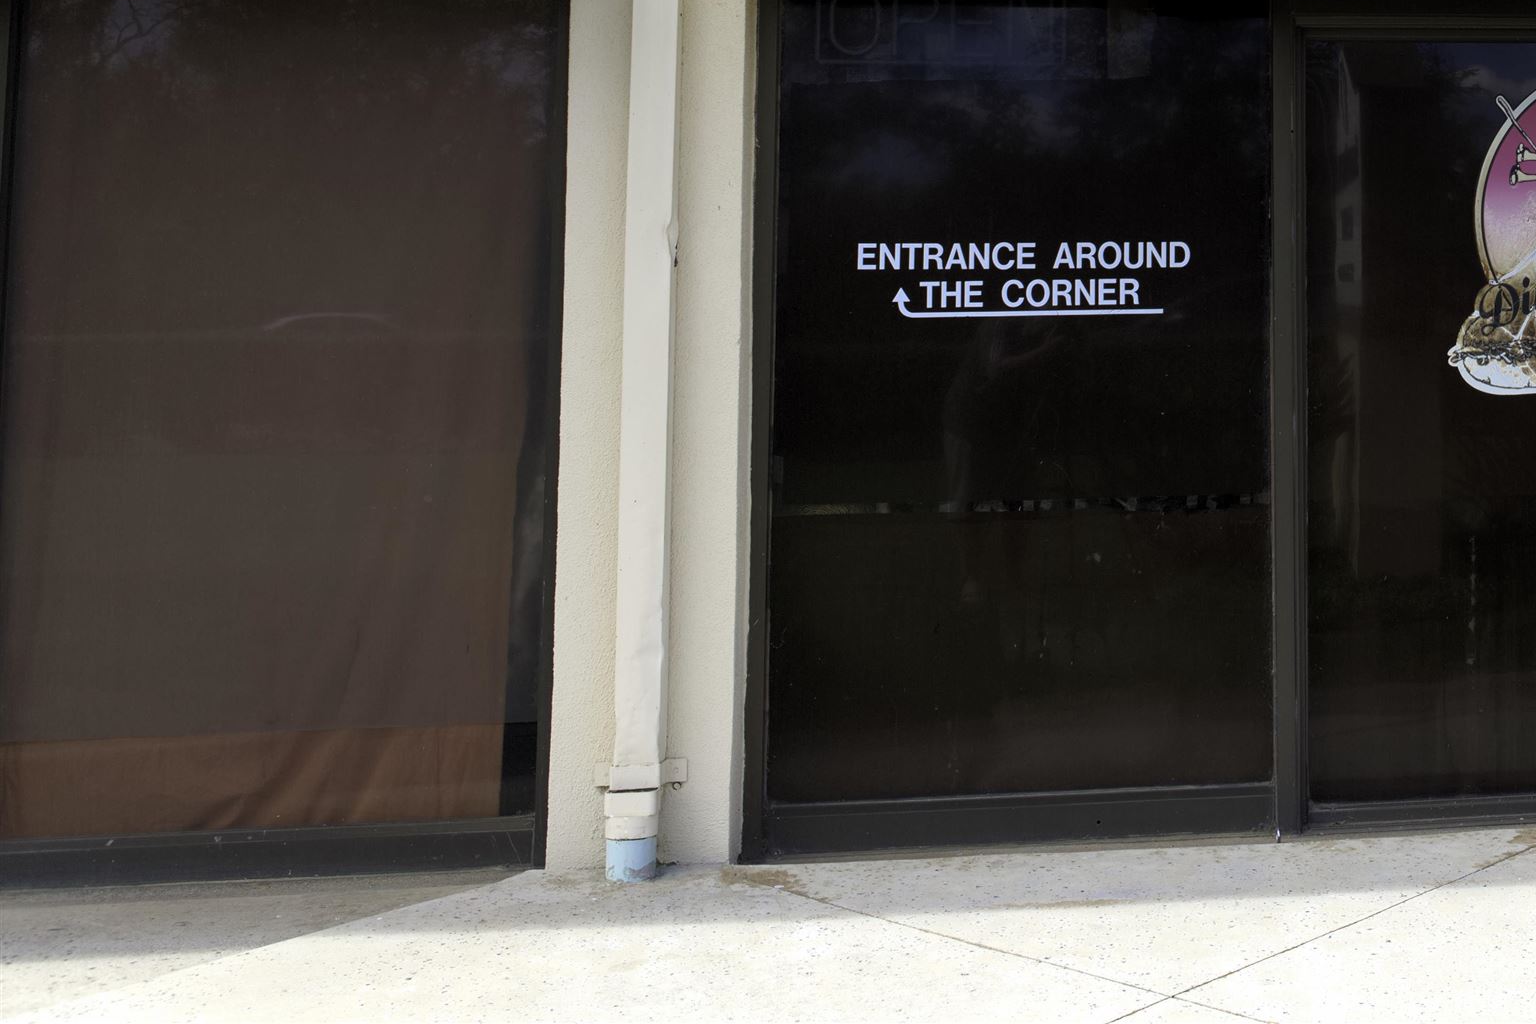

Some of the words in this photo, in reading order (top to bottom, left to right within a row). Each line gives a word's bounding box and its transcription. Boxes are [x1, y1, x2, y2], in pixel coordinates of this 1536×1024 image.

[856, 241, 1037, 271] ENTRANCE
[1052, 240, 1192, 269] AROUND
[919, 280, 984, 308] THE
[1001, 278, 1140, 308] CORNER
